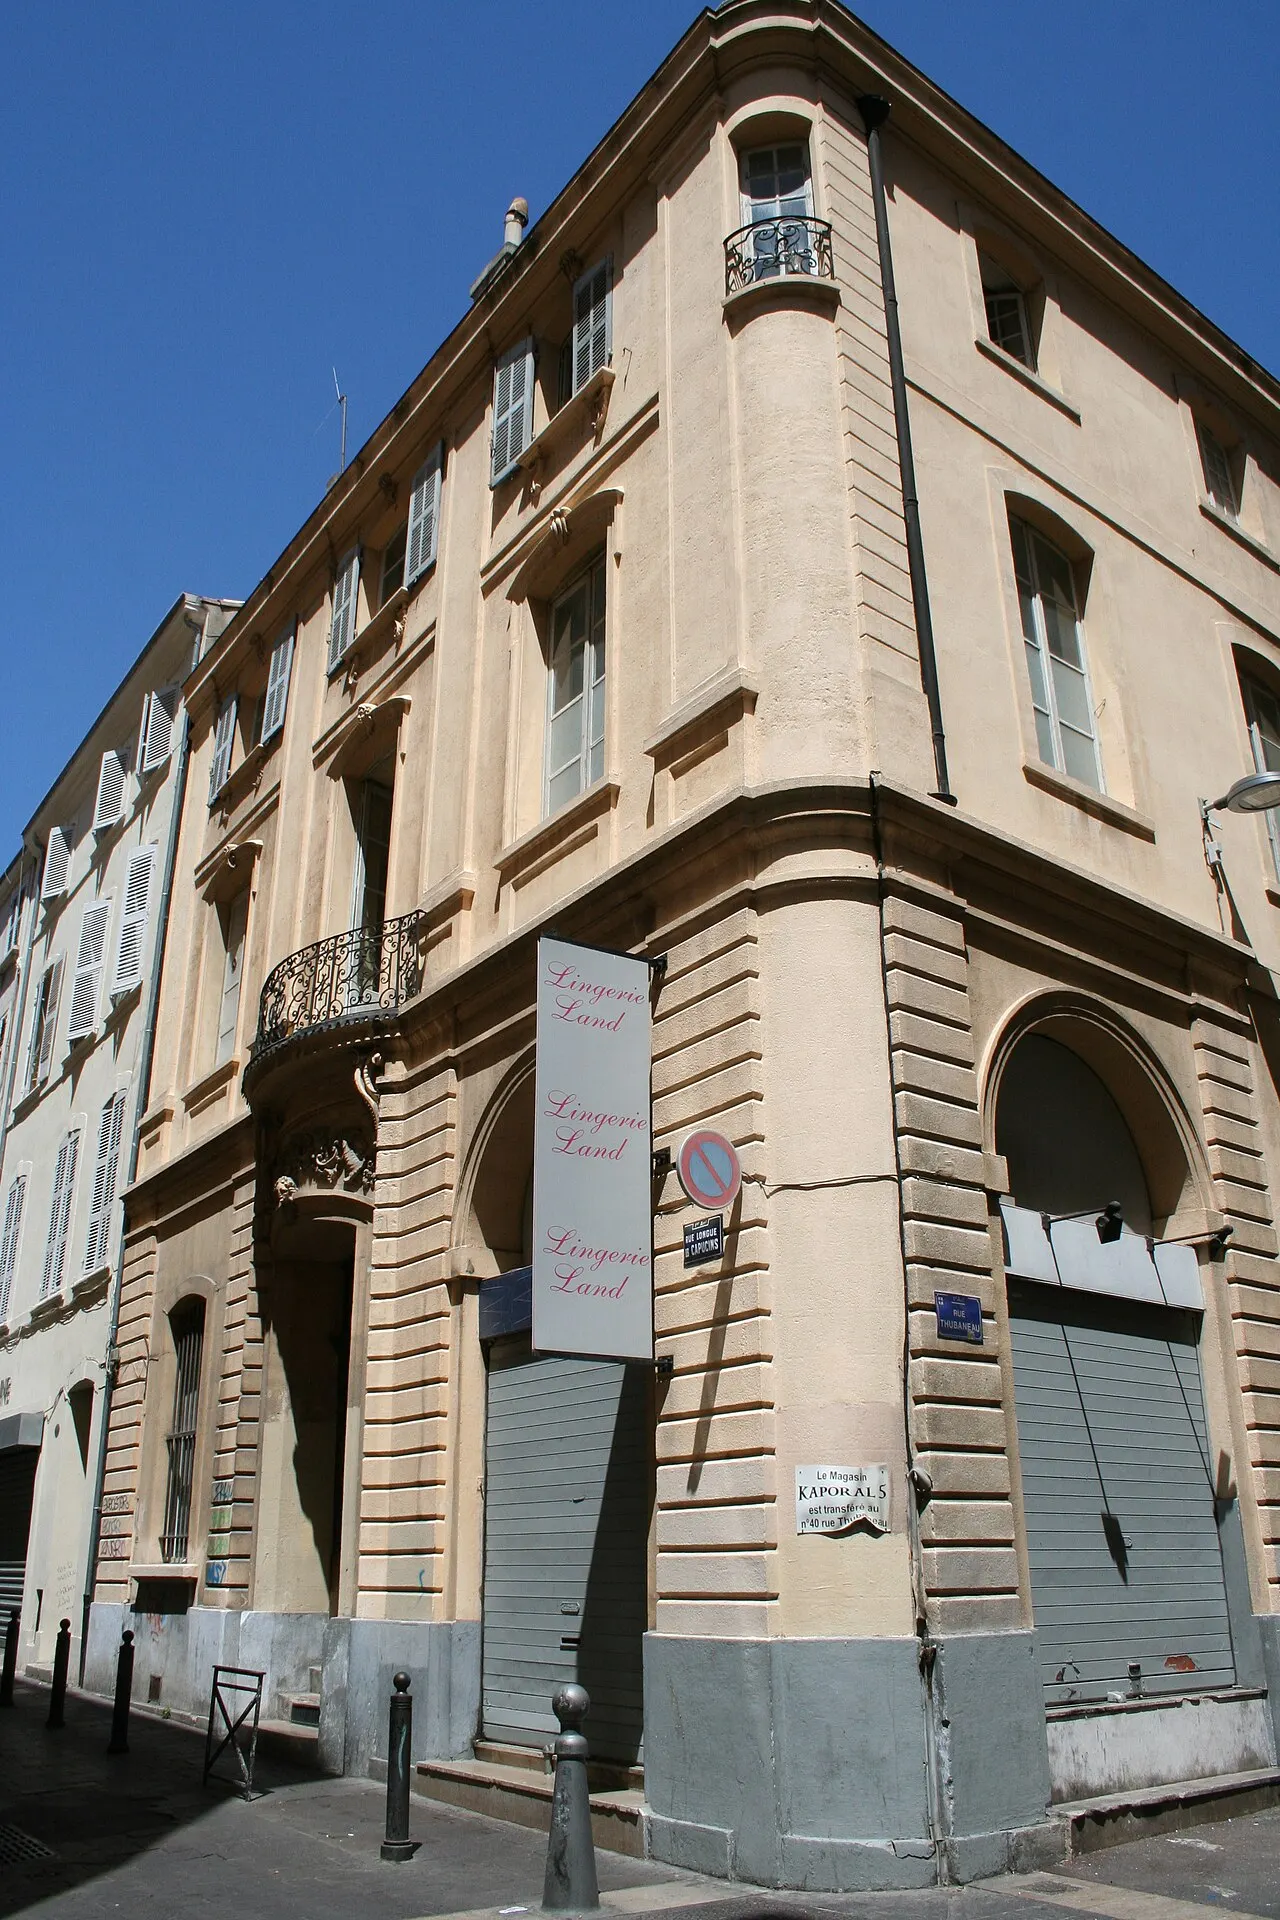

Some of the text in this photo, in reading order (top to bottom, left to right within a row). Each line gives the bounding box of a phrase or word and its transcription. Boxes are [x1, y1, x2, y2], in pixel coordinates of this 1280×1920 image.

[543, 961, 645, 1005] Lingerie
[551, 994, 626, 1032] Land
[543, 1089, 647, 1134] Lingerie
[551, 1125, 628, 1161] Land
[685, 1227, 718, 1244] RUE LONGUE
[542, 1225, 650, 1271] Lingerie
[690, 1238, 719, 1256] CAPUCINS
[549, 1263, 629, 1300] Land
[953, 1309, 966, 1318] RUE
[940, 1319, 980, 1333] THUBANEAU
[817, 1471, 867, 1483] Le Magasin
[798, 1484, 887, 1501] KAPORAL 5
[808, 1503, 879, 1515] est transféré au
[801, 1518, 819, 1529] n°40
[821, 1519, 835, 1528] rue
